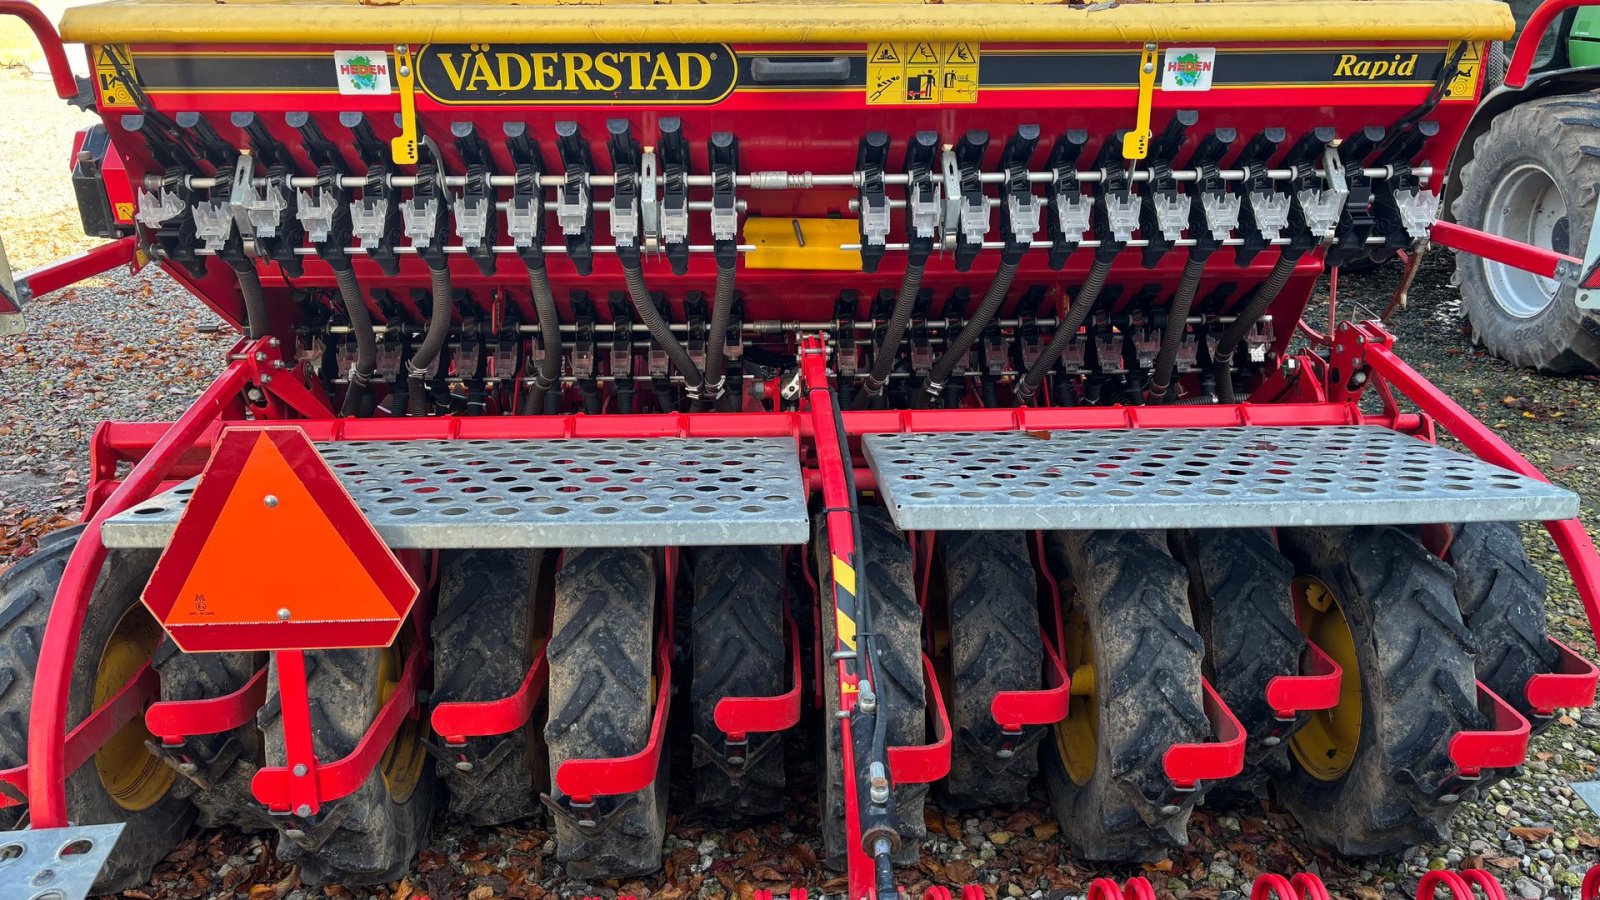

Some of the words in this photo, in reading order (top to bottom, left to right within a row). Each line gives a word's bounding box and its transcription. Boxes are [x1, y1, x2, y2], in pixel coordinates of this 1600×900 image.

[340, 64, 387, 75] HEDEN
[1168, 61, 1212, 72] HEDEN
[1333, 53, 1419, 79] Rapid
